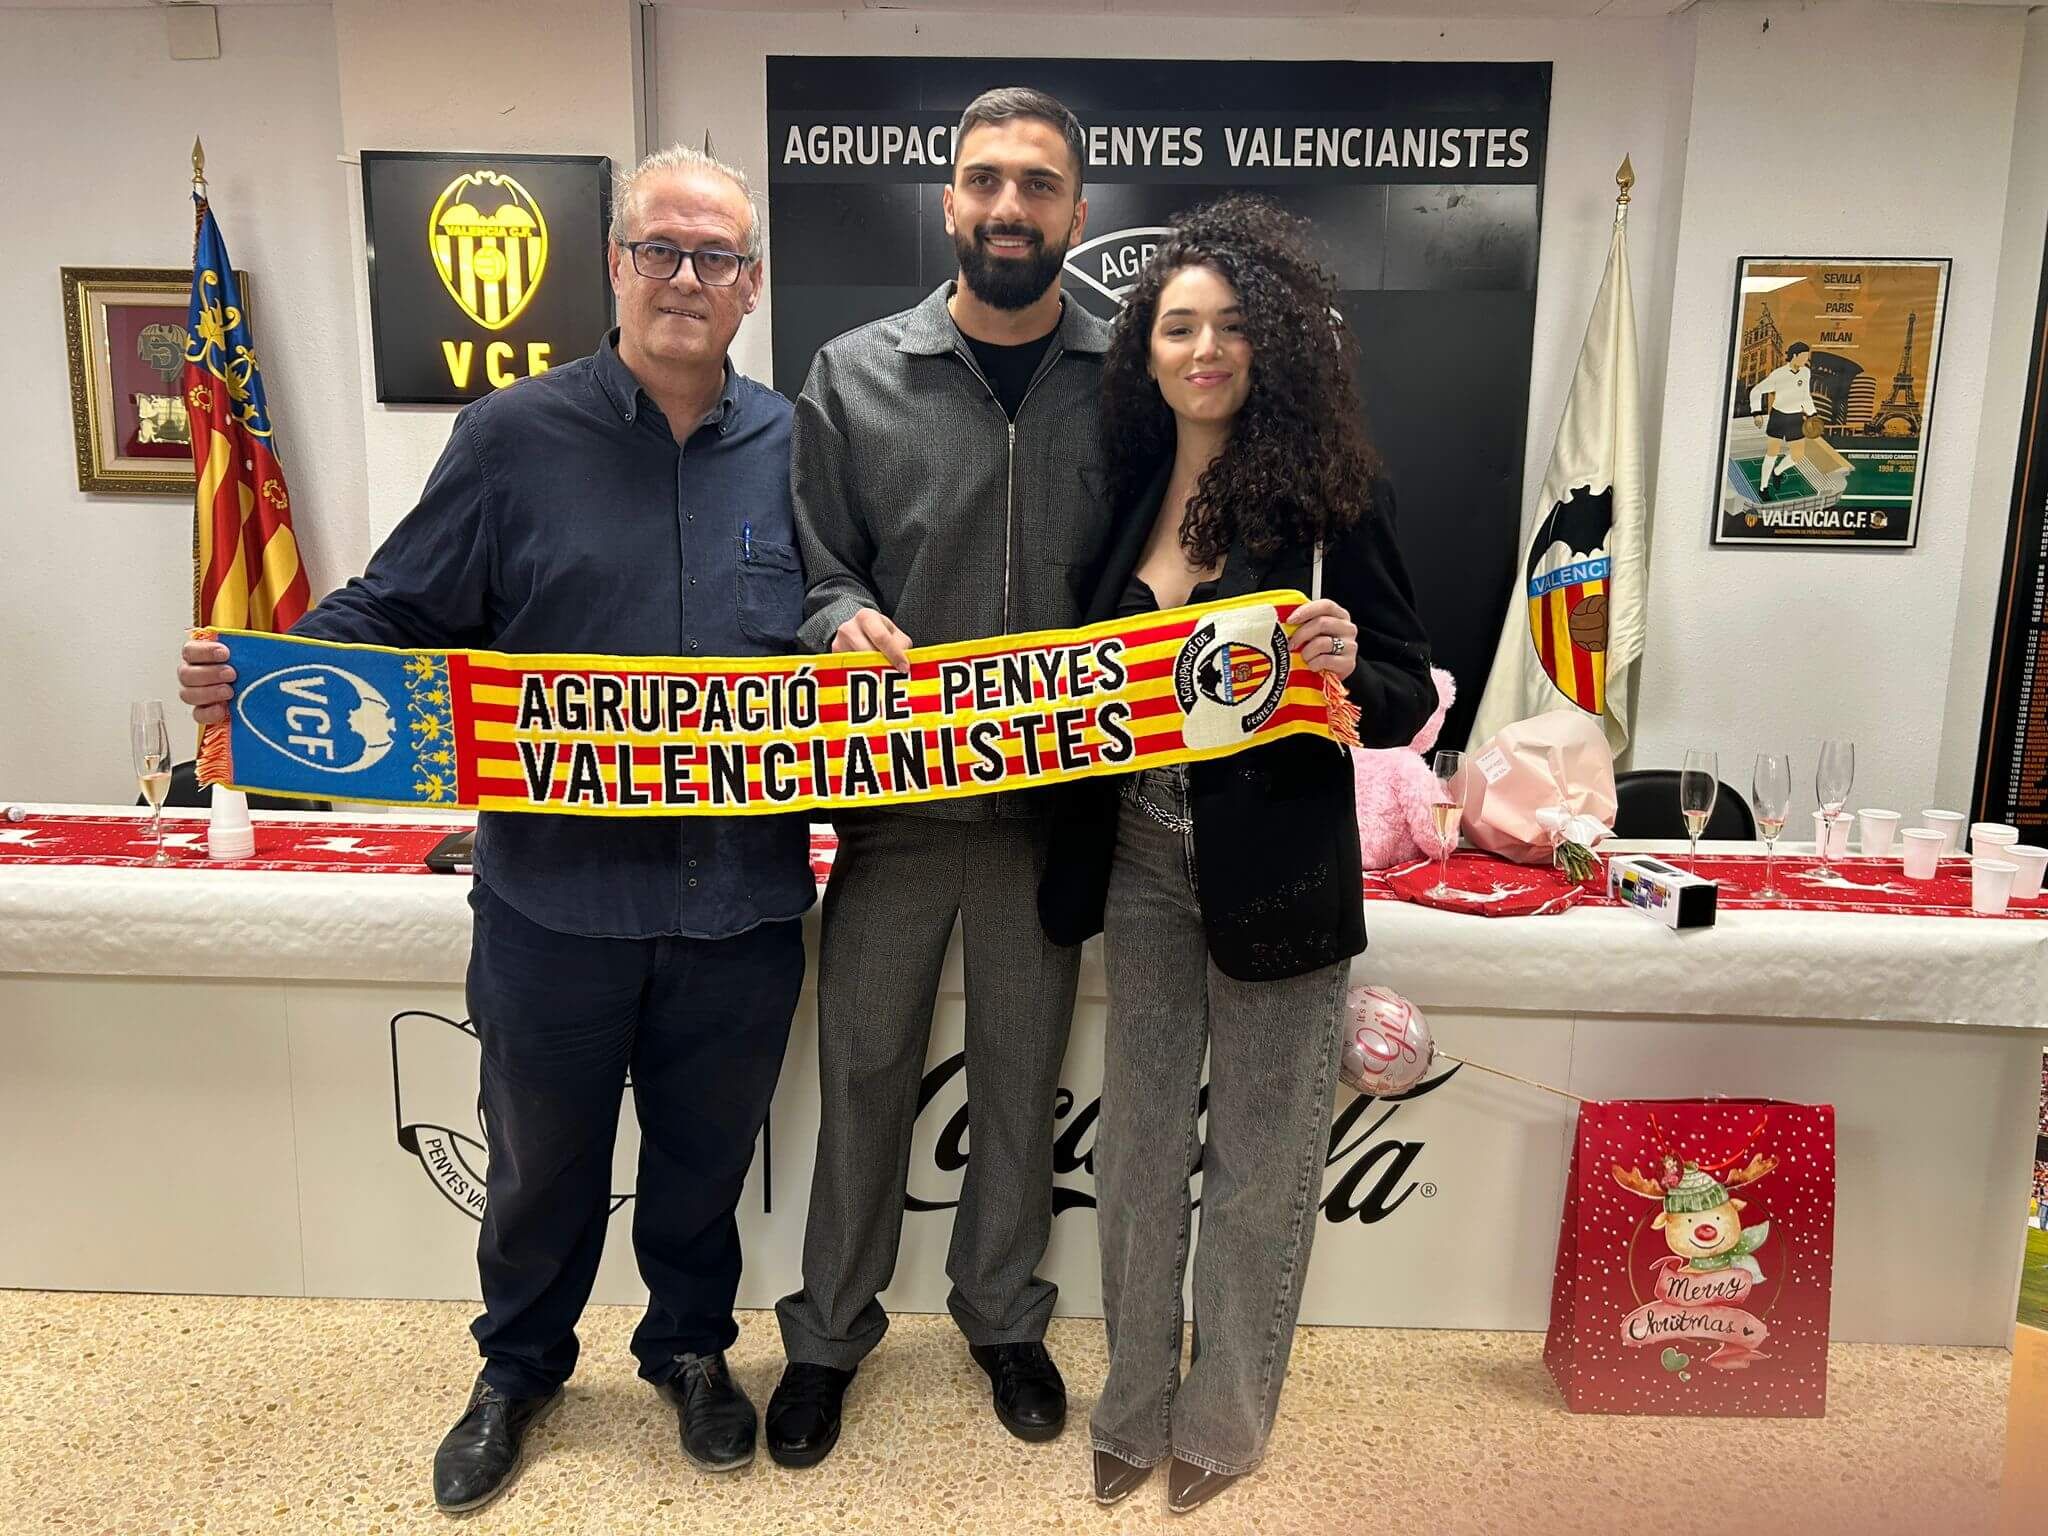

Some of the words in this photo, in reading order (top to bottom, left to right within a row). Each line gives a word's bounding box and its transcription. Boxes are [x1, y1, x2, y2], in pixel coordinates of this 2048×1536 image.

[1078, 125, 1203, 167] ENYES
[1224, 126, 1531, 169] VALENCIANISTES
[444, 225, 507, 237] VALENCIA
[1824, 273, 1861, 284] SEVILLA
[1825, 302, 1854, 313] PARIS
[1820, 331, 1853, 342] MILAN
[441, 341, 551, 389] VCF
[1761, 510, 1840, 528] VALENCIA
[1842, 511, 1868, 528] C.F.
[1534, 560, 1609, 594] VALENCI
[1195, 632, 1211, 648] DE
[517, 663, 820, 734] AGRUPACIÓ
[849, 670, 911, 726] DE
[941, 640, 1127, 715] PENYES
[279, 676, 335, 761] VCF
[516, 701, 1135, 806] VALENCIANISTES
[425, 1138, 469, 1196] PENYES
[464, 1188, 487, 1212] VA
[1666, 1275, 1748, 1302] Merry
[1628, 1311, 1737, 1342] Christmas
